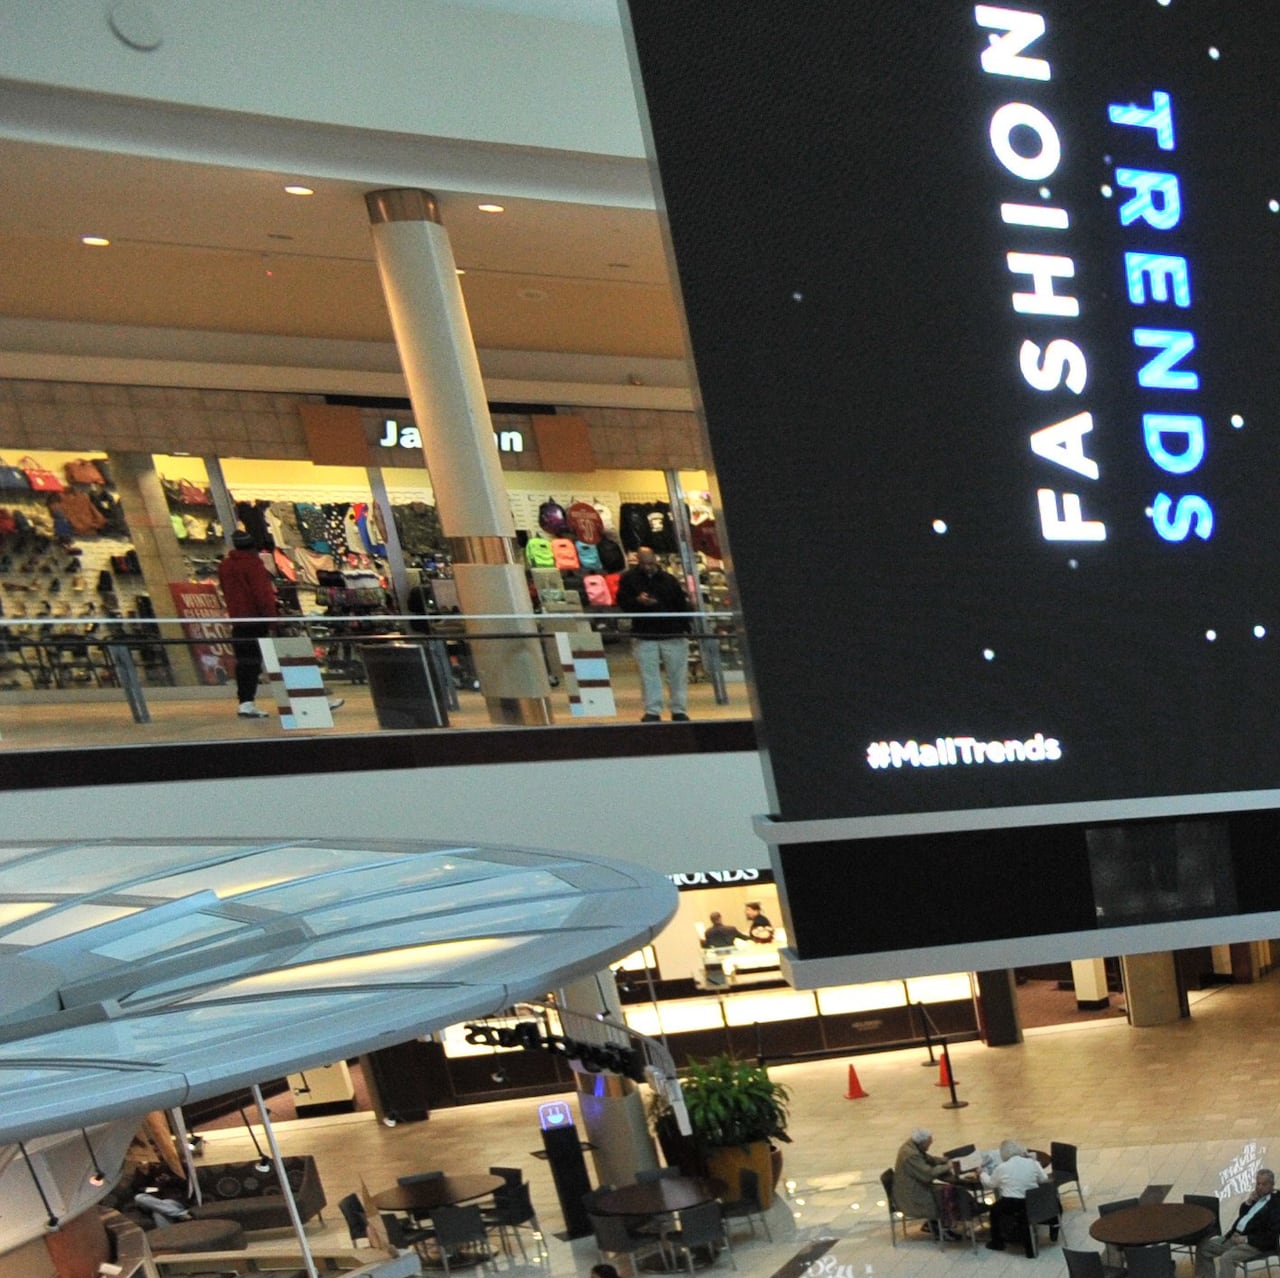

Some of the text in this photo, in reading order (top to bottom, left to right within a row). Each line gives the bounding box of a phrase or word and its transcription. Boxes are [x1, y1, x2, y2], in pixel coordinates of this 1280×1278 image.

[974, 4, 1107, 542] FASHION
[1106, 89, 1216, 545] TRENDS
[866, 733, 1062, 769] #MallTrends
